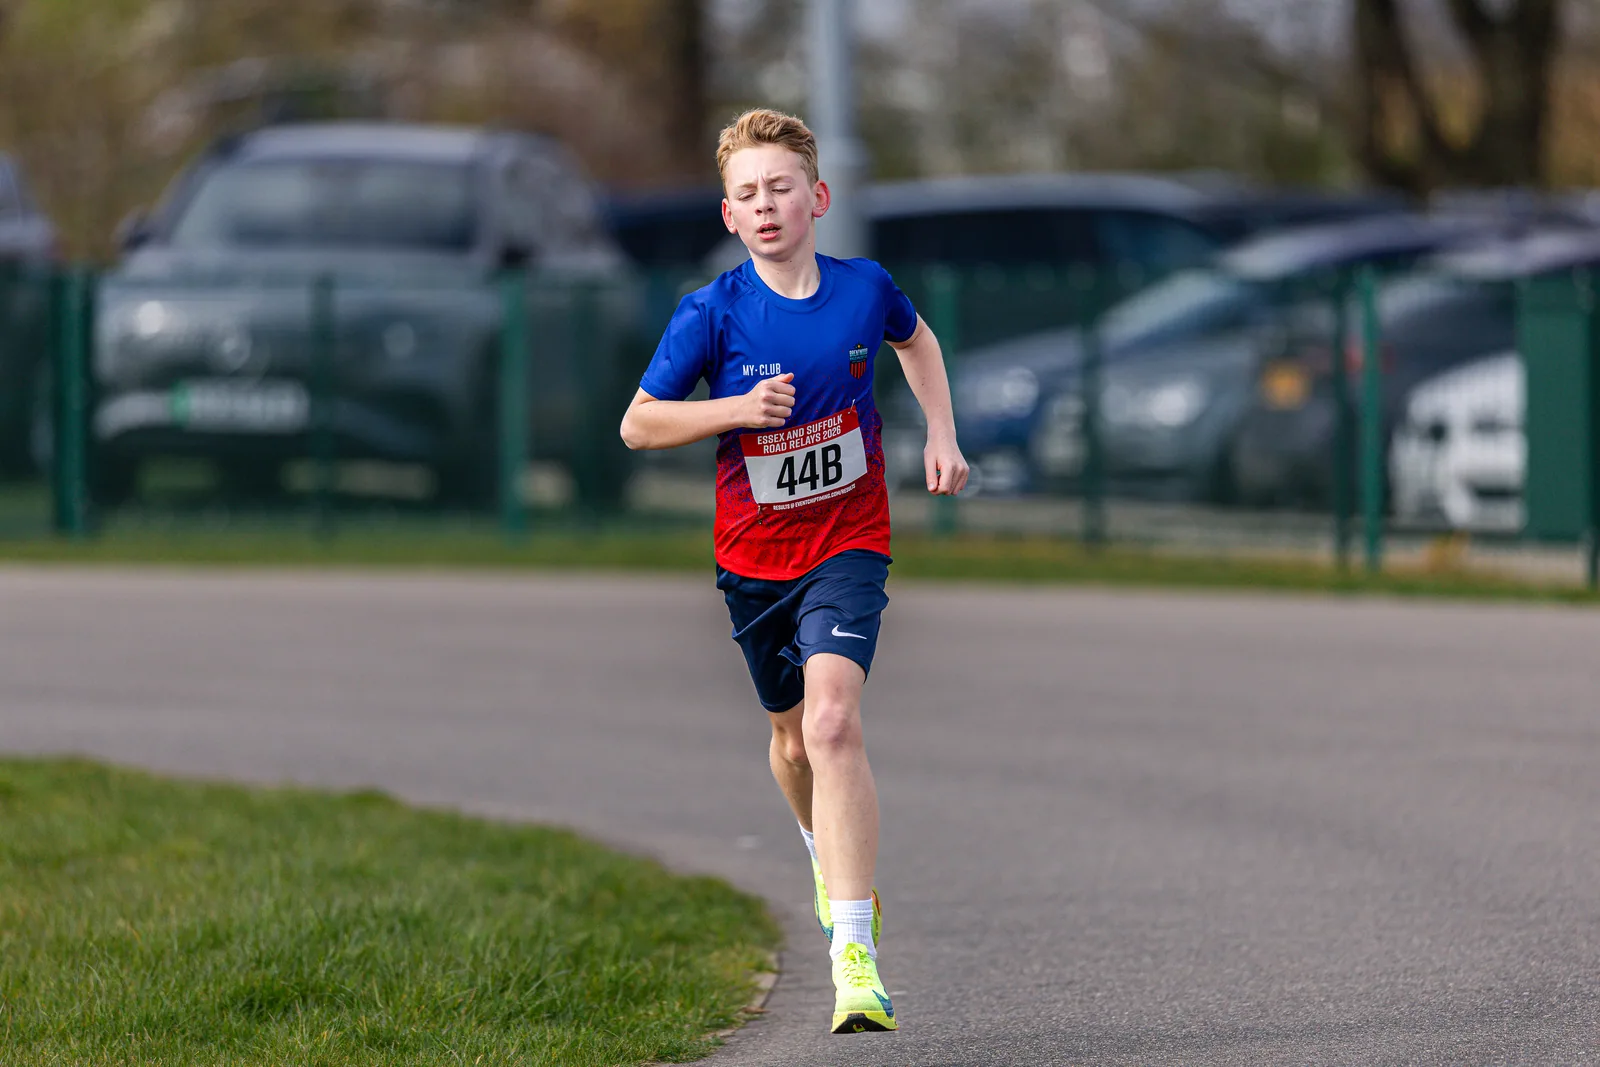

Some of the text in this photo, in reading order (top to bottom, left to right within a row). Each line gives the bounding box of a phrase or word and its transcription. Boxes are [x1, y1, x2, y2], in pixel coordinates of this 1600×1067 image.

[757, 414, 843, 445] ESSEX AND SUFFOLK
[763, 425, 841, 454] ROAD RELAYS 2026
[776, 443, 842, 496] 44B
[772, 503, 790, 511] RESULTS
